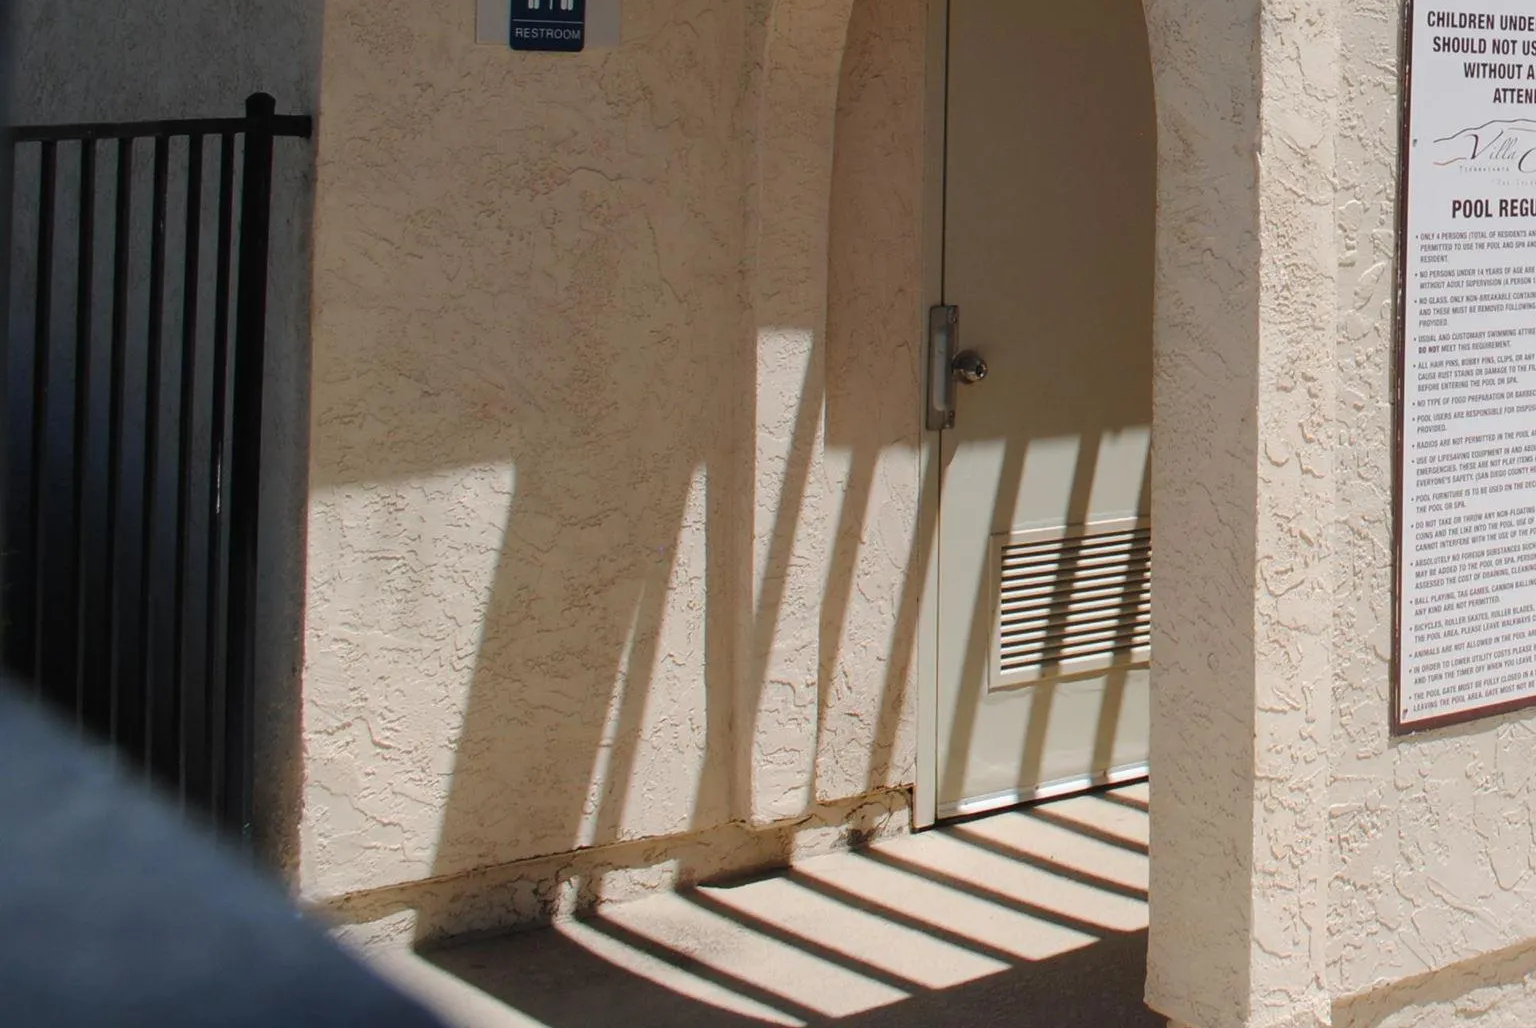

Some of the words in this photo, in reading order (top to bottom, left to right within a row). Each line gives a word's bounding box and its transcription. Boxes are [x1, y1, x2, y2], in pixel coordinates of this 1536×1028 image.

[1427, 10, 1494, 30] CHILDREN
[514, 27, 581, 41] RESTROOM
[1433, 36, 1486, 54] SHOULD
[1492, 38, 1517, 55] NOT
[1463, 62, 1522, 79] WITHOUT
[1464, 129, 1518, 161] Villa
[1452, 199, 1492, 218] POOL
